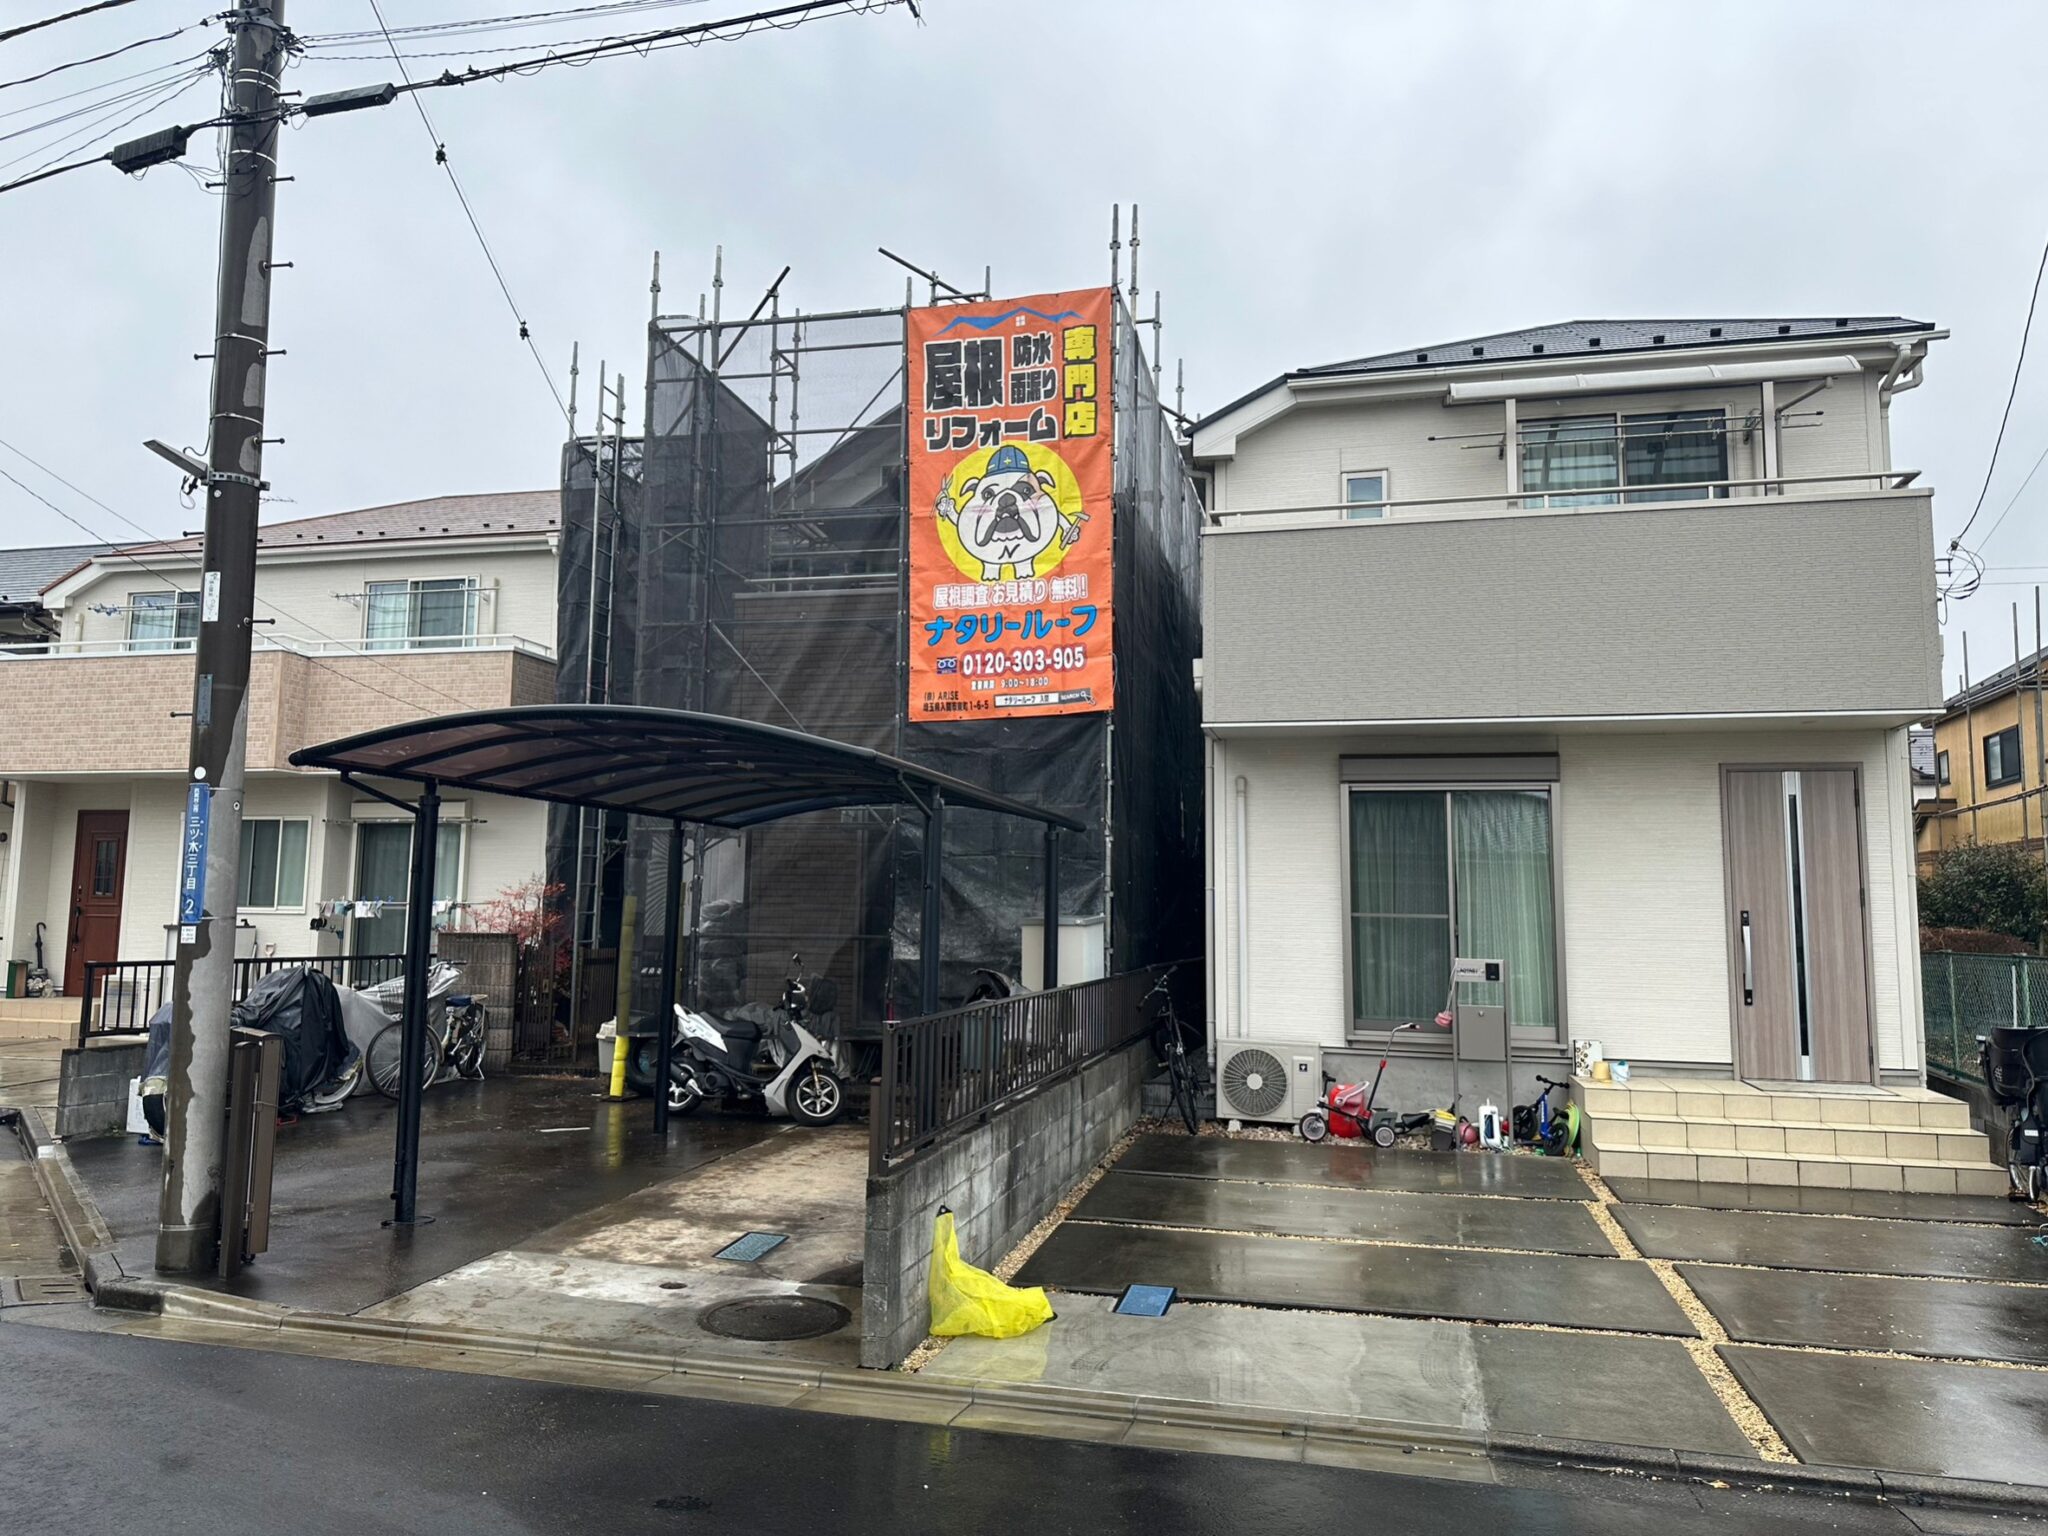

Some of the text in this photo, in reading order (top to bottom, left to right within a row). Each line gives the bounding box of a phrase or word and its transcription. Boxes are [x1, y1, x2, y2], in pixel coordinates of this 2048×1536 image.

[1011, 331, 1052, 369] 防水
[925, 337, 1004, 412] 屋根
[1009, 367, 1057, 405] 雨漏り
[1062, 325, 1096, 438] 専門店
[924, 407, 1057, 451] リフォーム
[934, 584, 988, 609] 屋根調査
[992, 580, 1047, 605] お見積り
[925, 605, 1098, 646] ナタリールーフ
[963, 646, 1084, 675] 0120-303-905
[938, 690, 959, 700] ARISE
[187, 816, 200, 890] 三ツ木三丁目
[185, 898, 194, 914] 2
